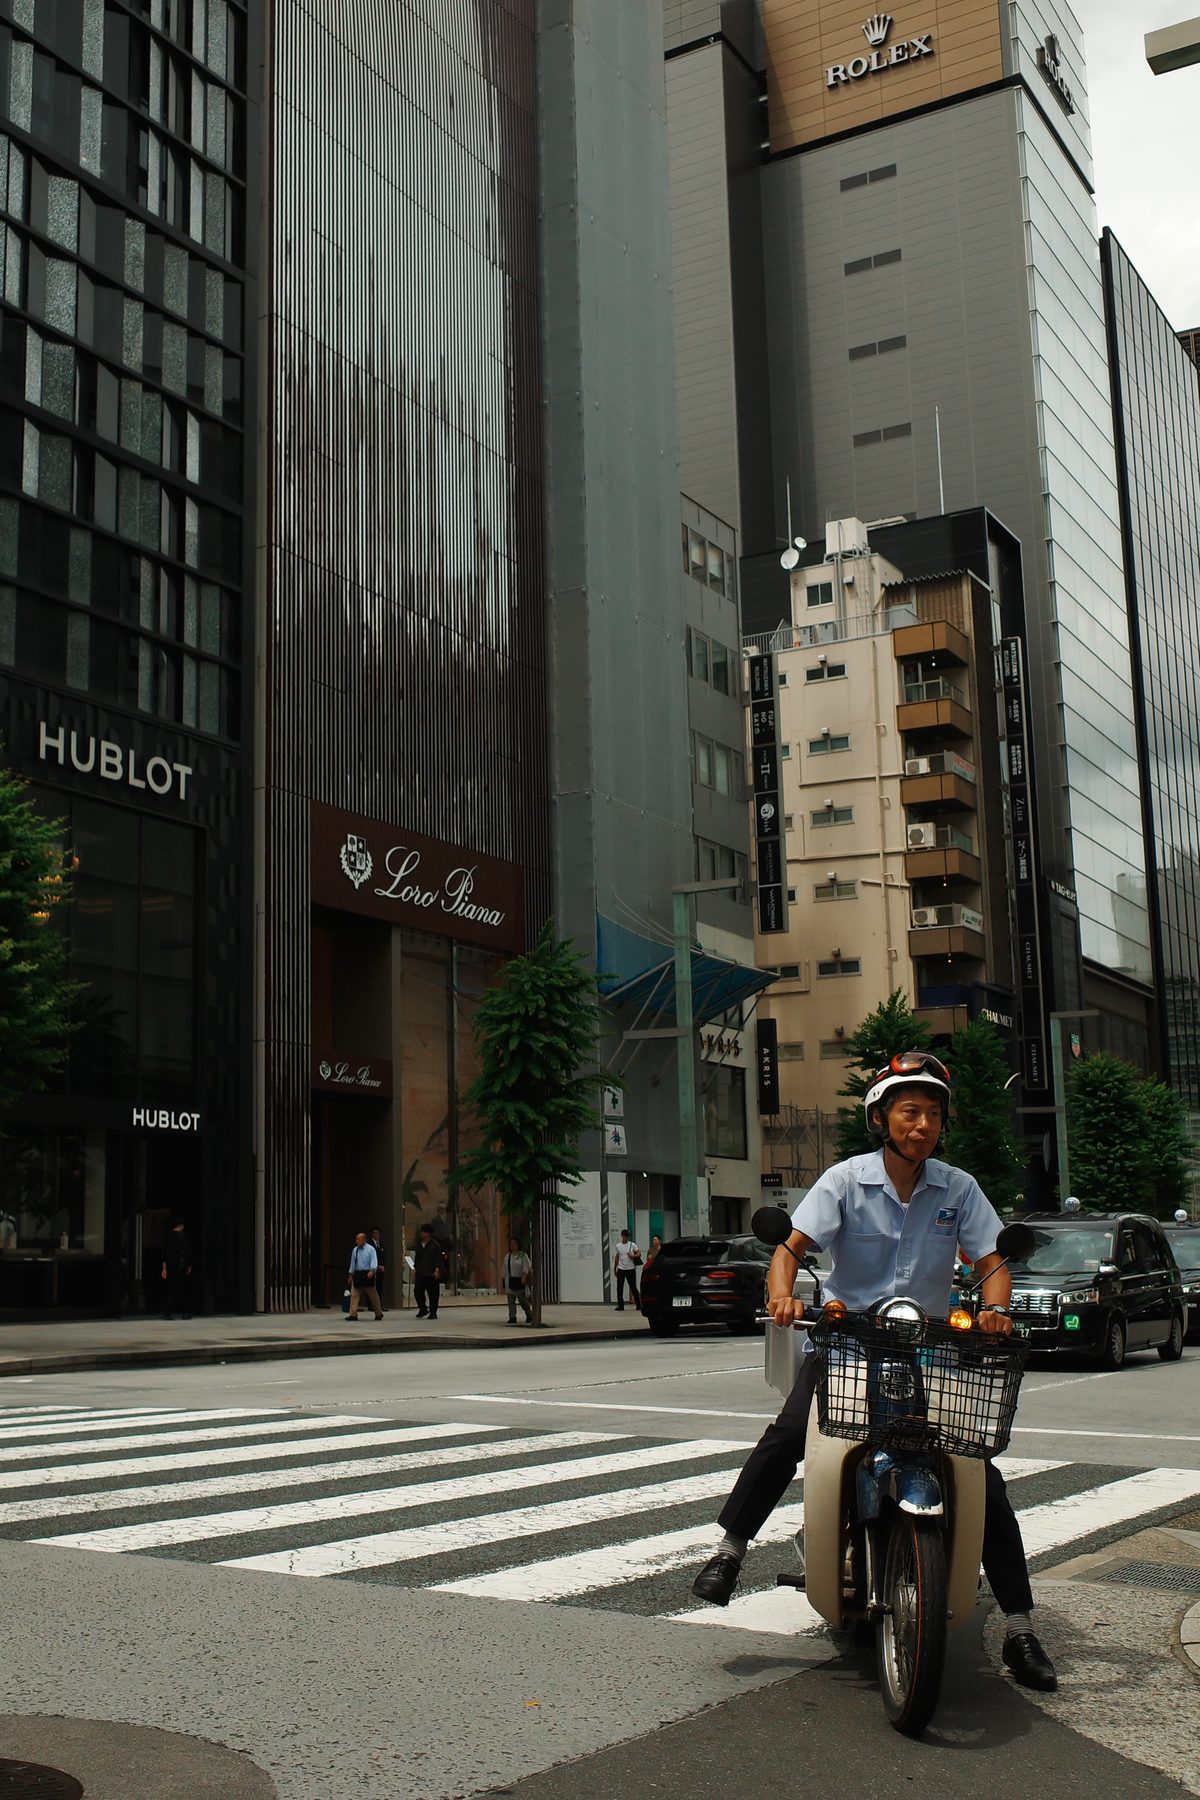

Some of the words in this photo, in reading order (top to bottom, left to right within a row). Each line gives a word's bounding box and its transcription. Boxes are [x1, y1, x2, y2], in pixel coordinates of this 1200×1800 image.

[826, 33, 934, 88] ROLEX
[39, 720, 193, 801] HUBLOT
[374, 845, 441, 907] Loro
[440, 866, 505, 927] Piana
[1024, 941, 1033, 981] CHAUMET
[331, 1061, 355, 1083] Loro
[355, 1063, 382, 1088] Piana
[762, 1047, 772, 1087] AKRIS
[133, 1108, 201, 1131] HUBLOT
